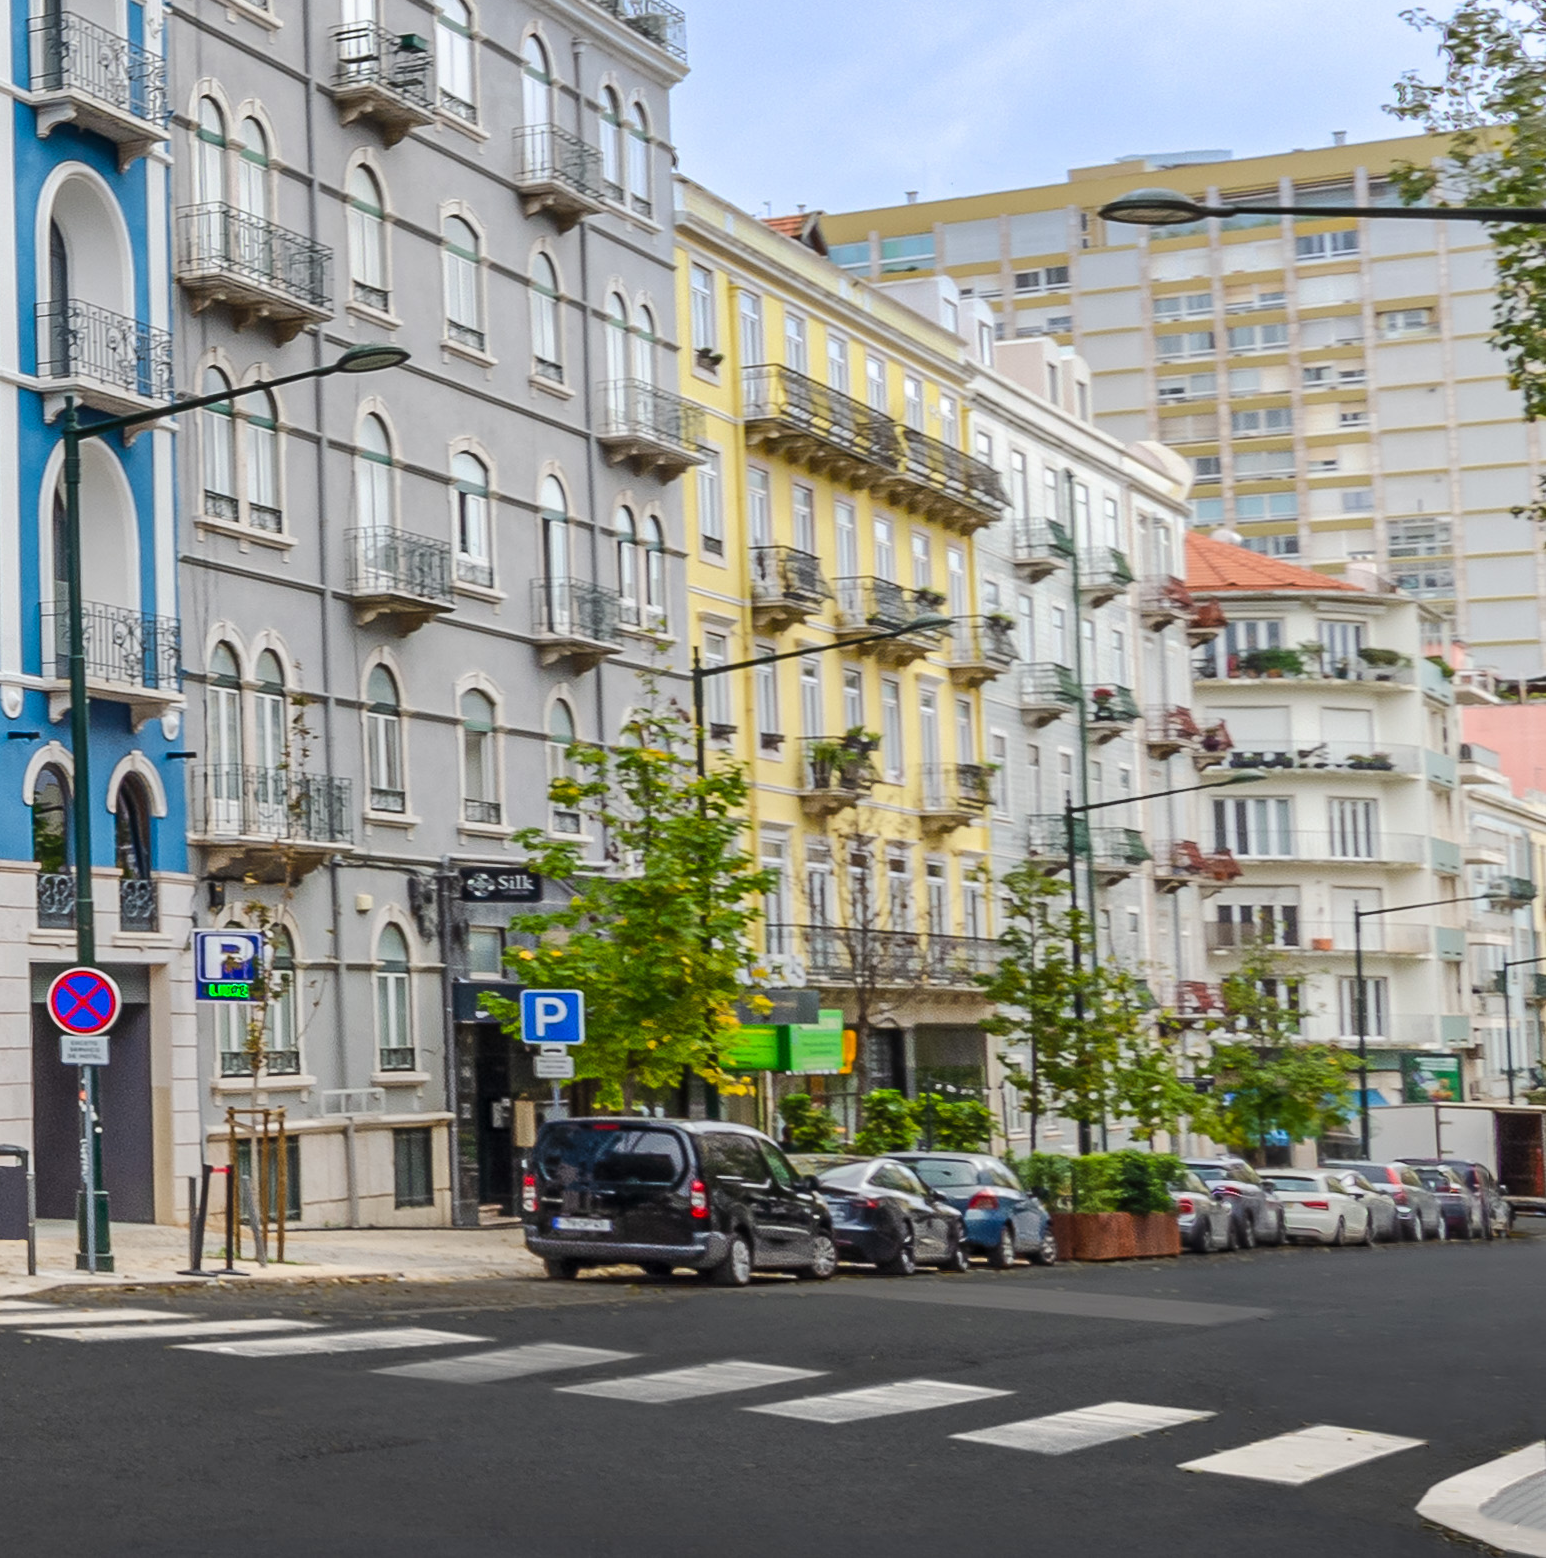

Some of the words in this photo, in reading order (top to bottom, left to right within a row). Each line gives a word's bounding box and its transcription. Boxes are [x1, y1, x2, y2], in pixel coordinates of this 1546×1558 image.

[497, 874, 536, 890] Silk
[204, 935, 255, 979] P
[535, 996, 568, 1037] P
